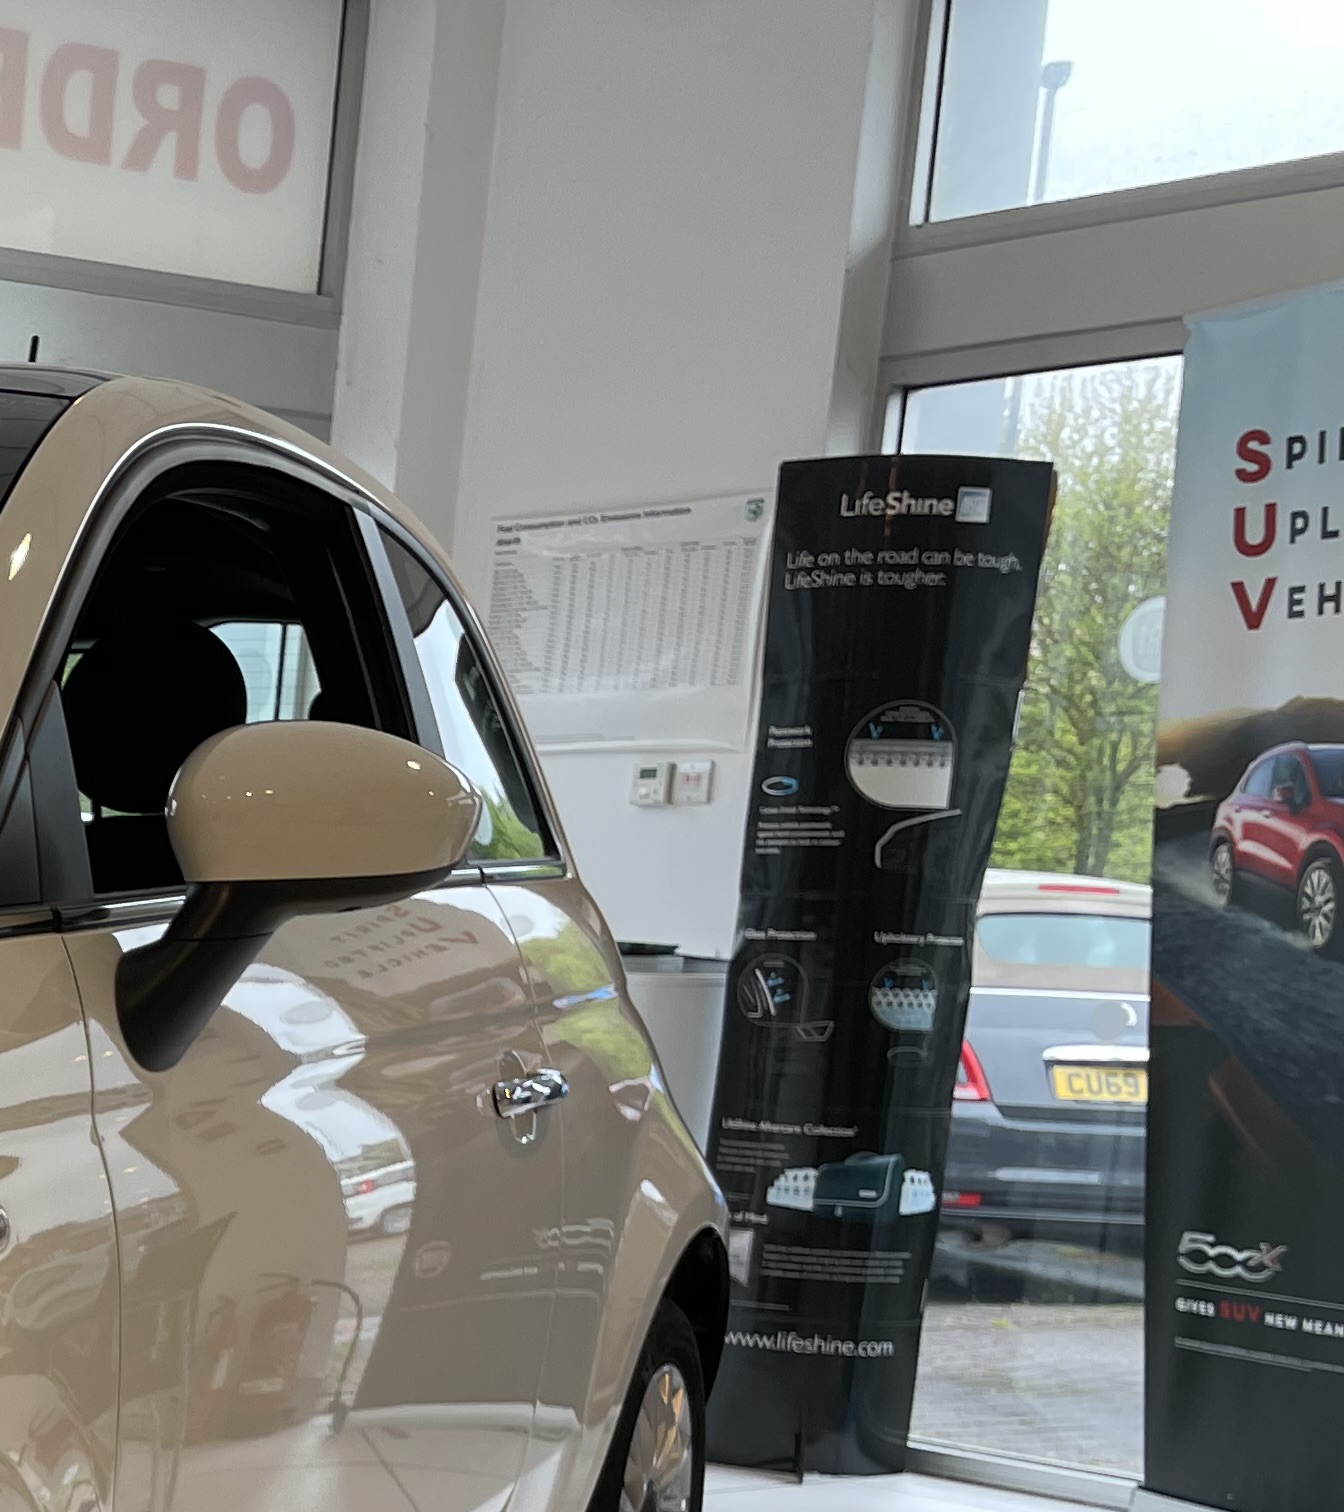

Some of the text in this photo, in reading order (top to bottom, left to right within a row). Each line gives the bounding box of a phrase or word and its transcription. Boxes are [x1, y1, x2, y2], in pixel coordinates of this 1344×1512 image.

[839, 489, 955, 518] LifeShine
[786, 549, 815, 570] Life
[817, 552, 841, 567] on
[844, 547, 874, 567] the
[877, 546, 920, 566] road
[922, 550, 951, 567] can
[953, 547, 975, 567] be
[784, 569, 856, 590] LifeShine
[860, 569, 874, 586] is
[1067, 1071, 1140, 1097] CU69
[1219, 1300, 1262, 1323] SUV
[1263, 1311, 1299, 1331] NEW
